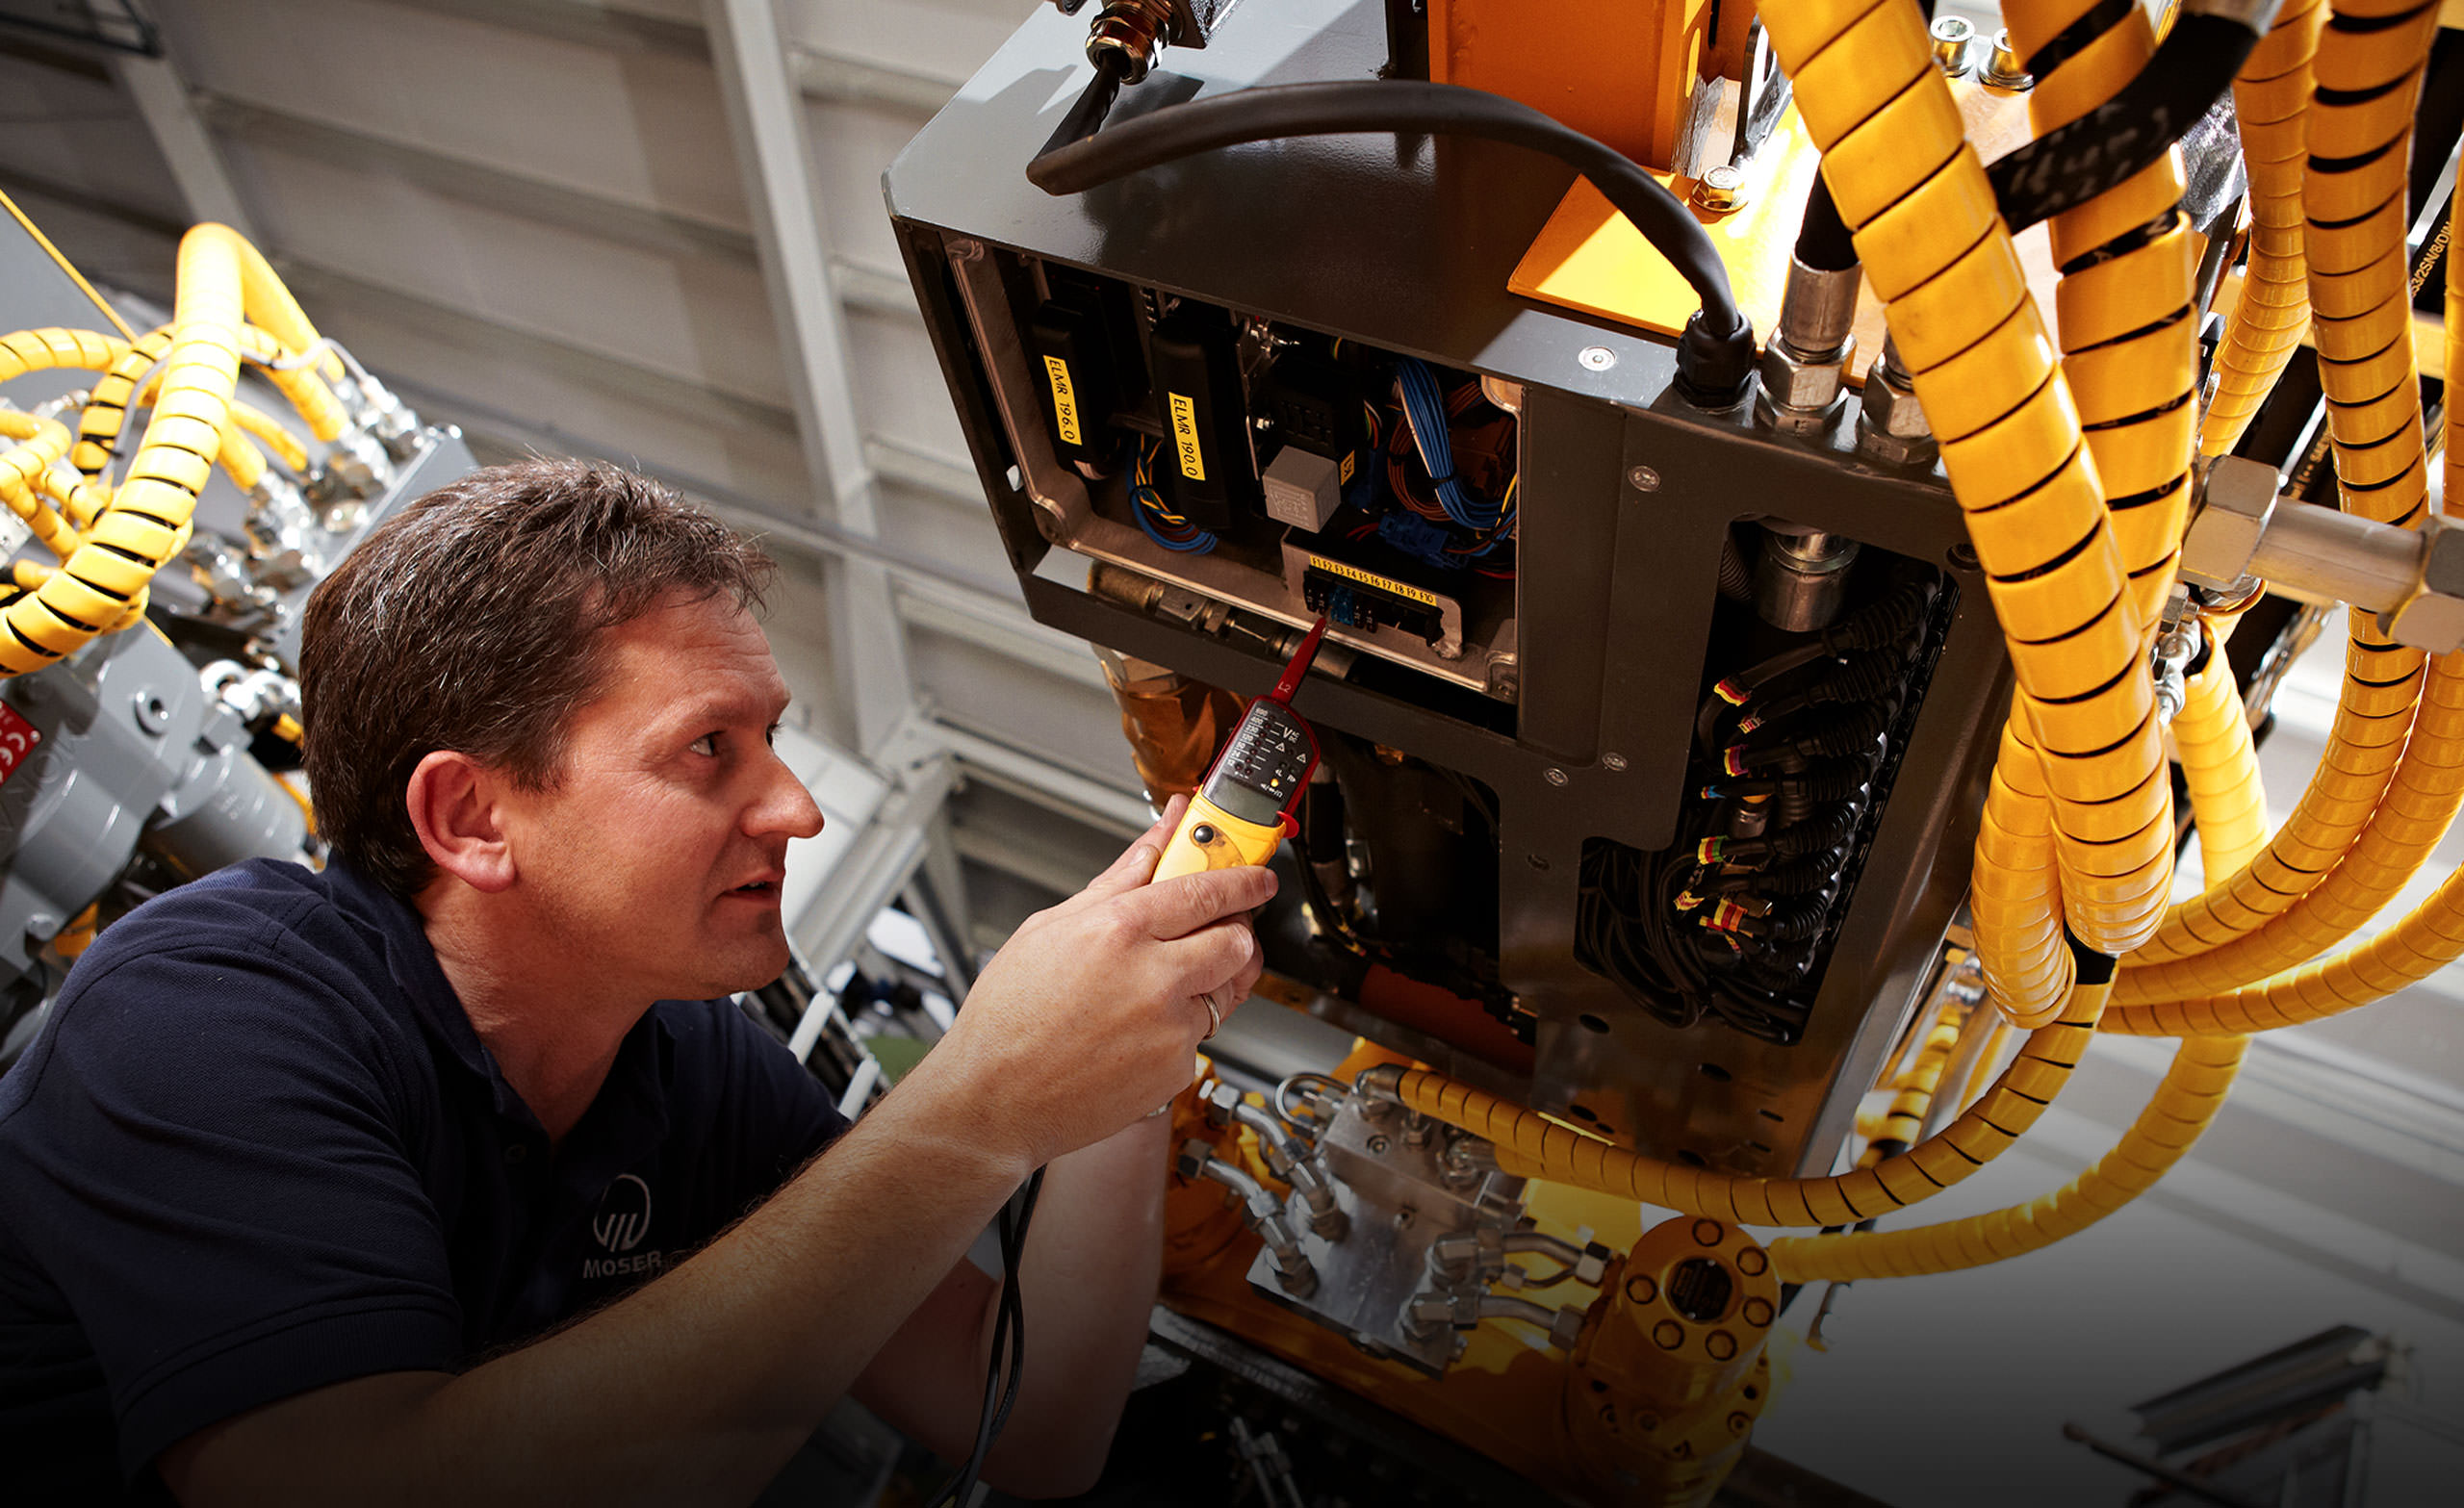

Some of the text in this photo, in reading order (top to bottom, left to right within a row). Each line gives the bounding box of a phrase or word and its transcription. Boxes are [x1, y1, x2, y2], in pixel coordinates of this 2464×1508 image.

[1048, 359, 1075, 441] ELMR 196.0
[1173, 397, 1198, 476] ELMR 190.0
[1278, 681, 1292, 694] L2
[1283, 727, 1293, 738] V
[582, 1250, 662, 1279] MOSER
